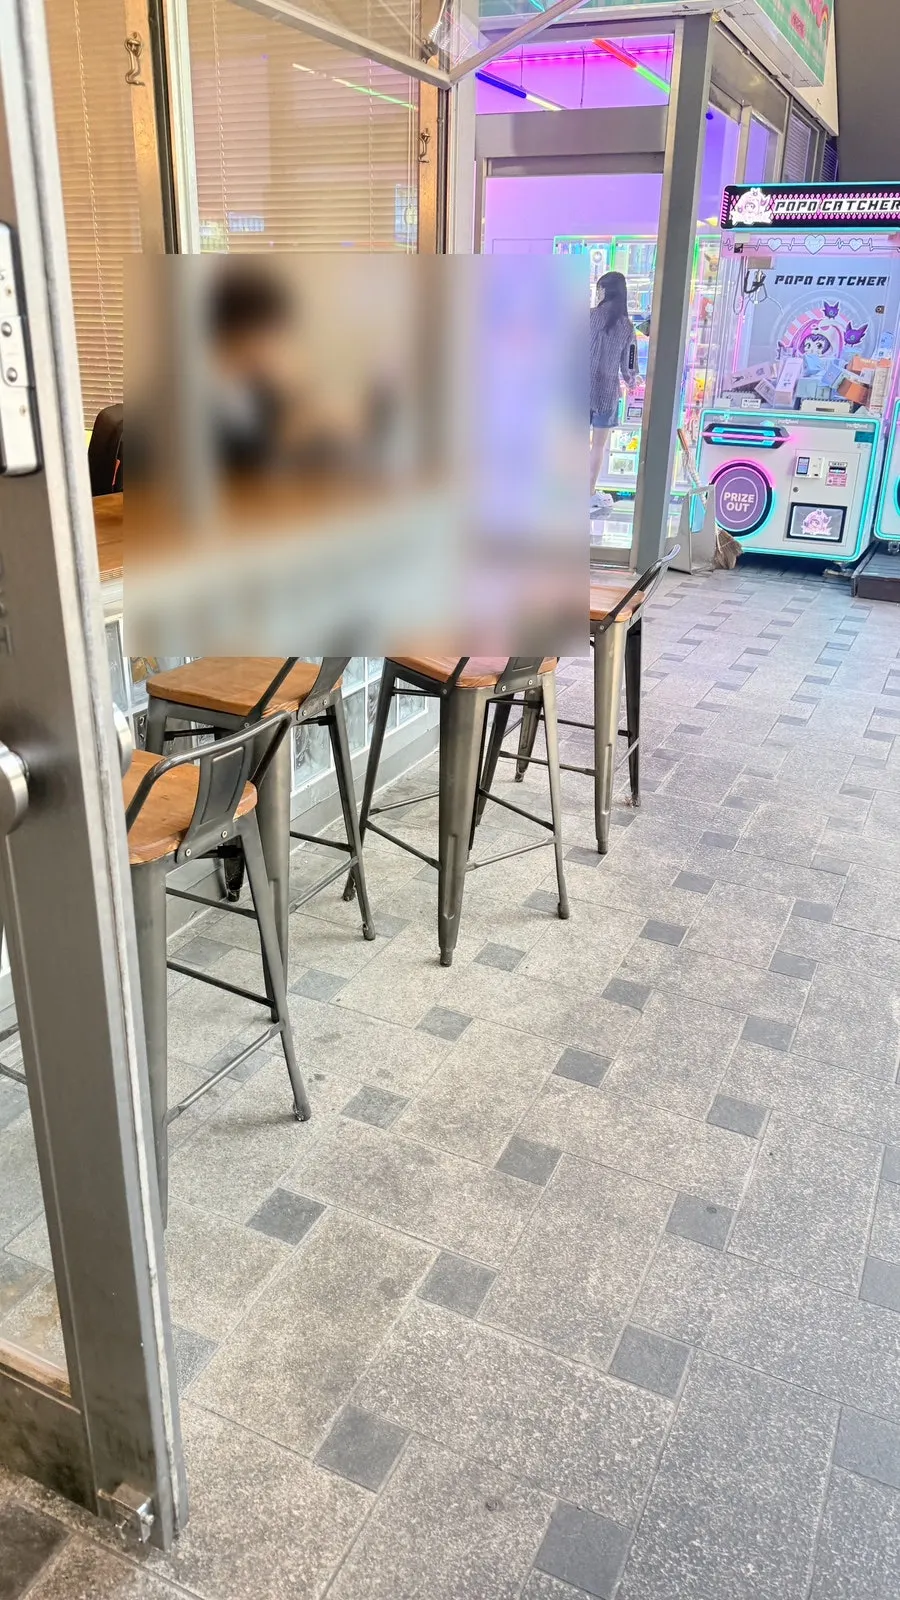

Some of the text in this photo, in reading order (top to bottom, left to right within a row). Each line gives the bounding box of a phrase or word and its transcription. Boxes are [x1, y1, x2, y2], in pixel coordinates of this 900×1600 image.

[775, 200, 900, 211] POPO CATCHER
[774, 275, 887, 286] POPO CATCHER
[723, 492, 755, 503] PRIZE
[726, 501, 750, 512] OUT
